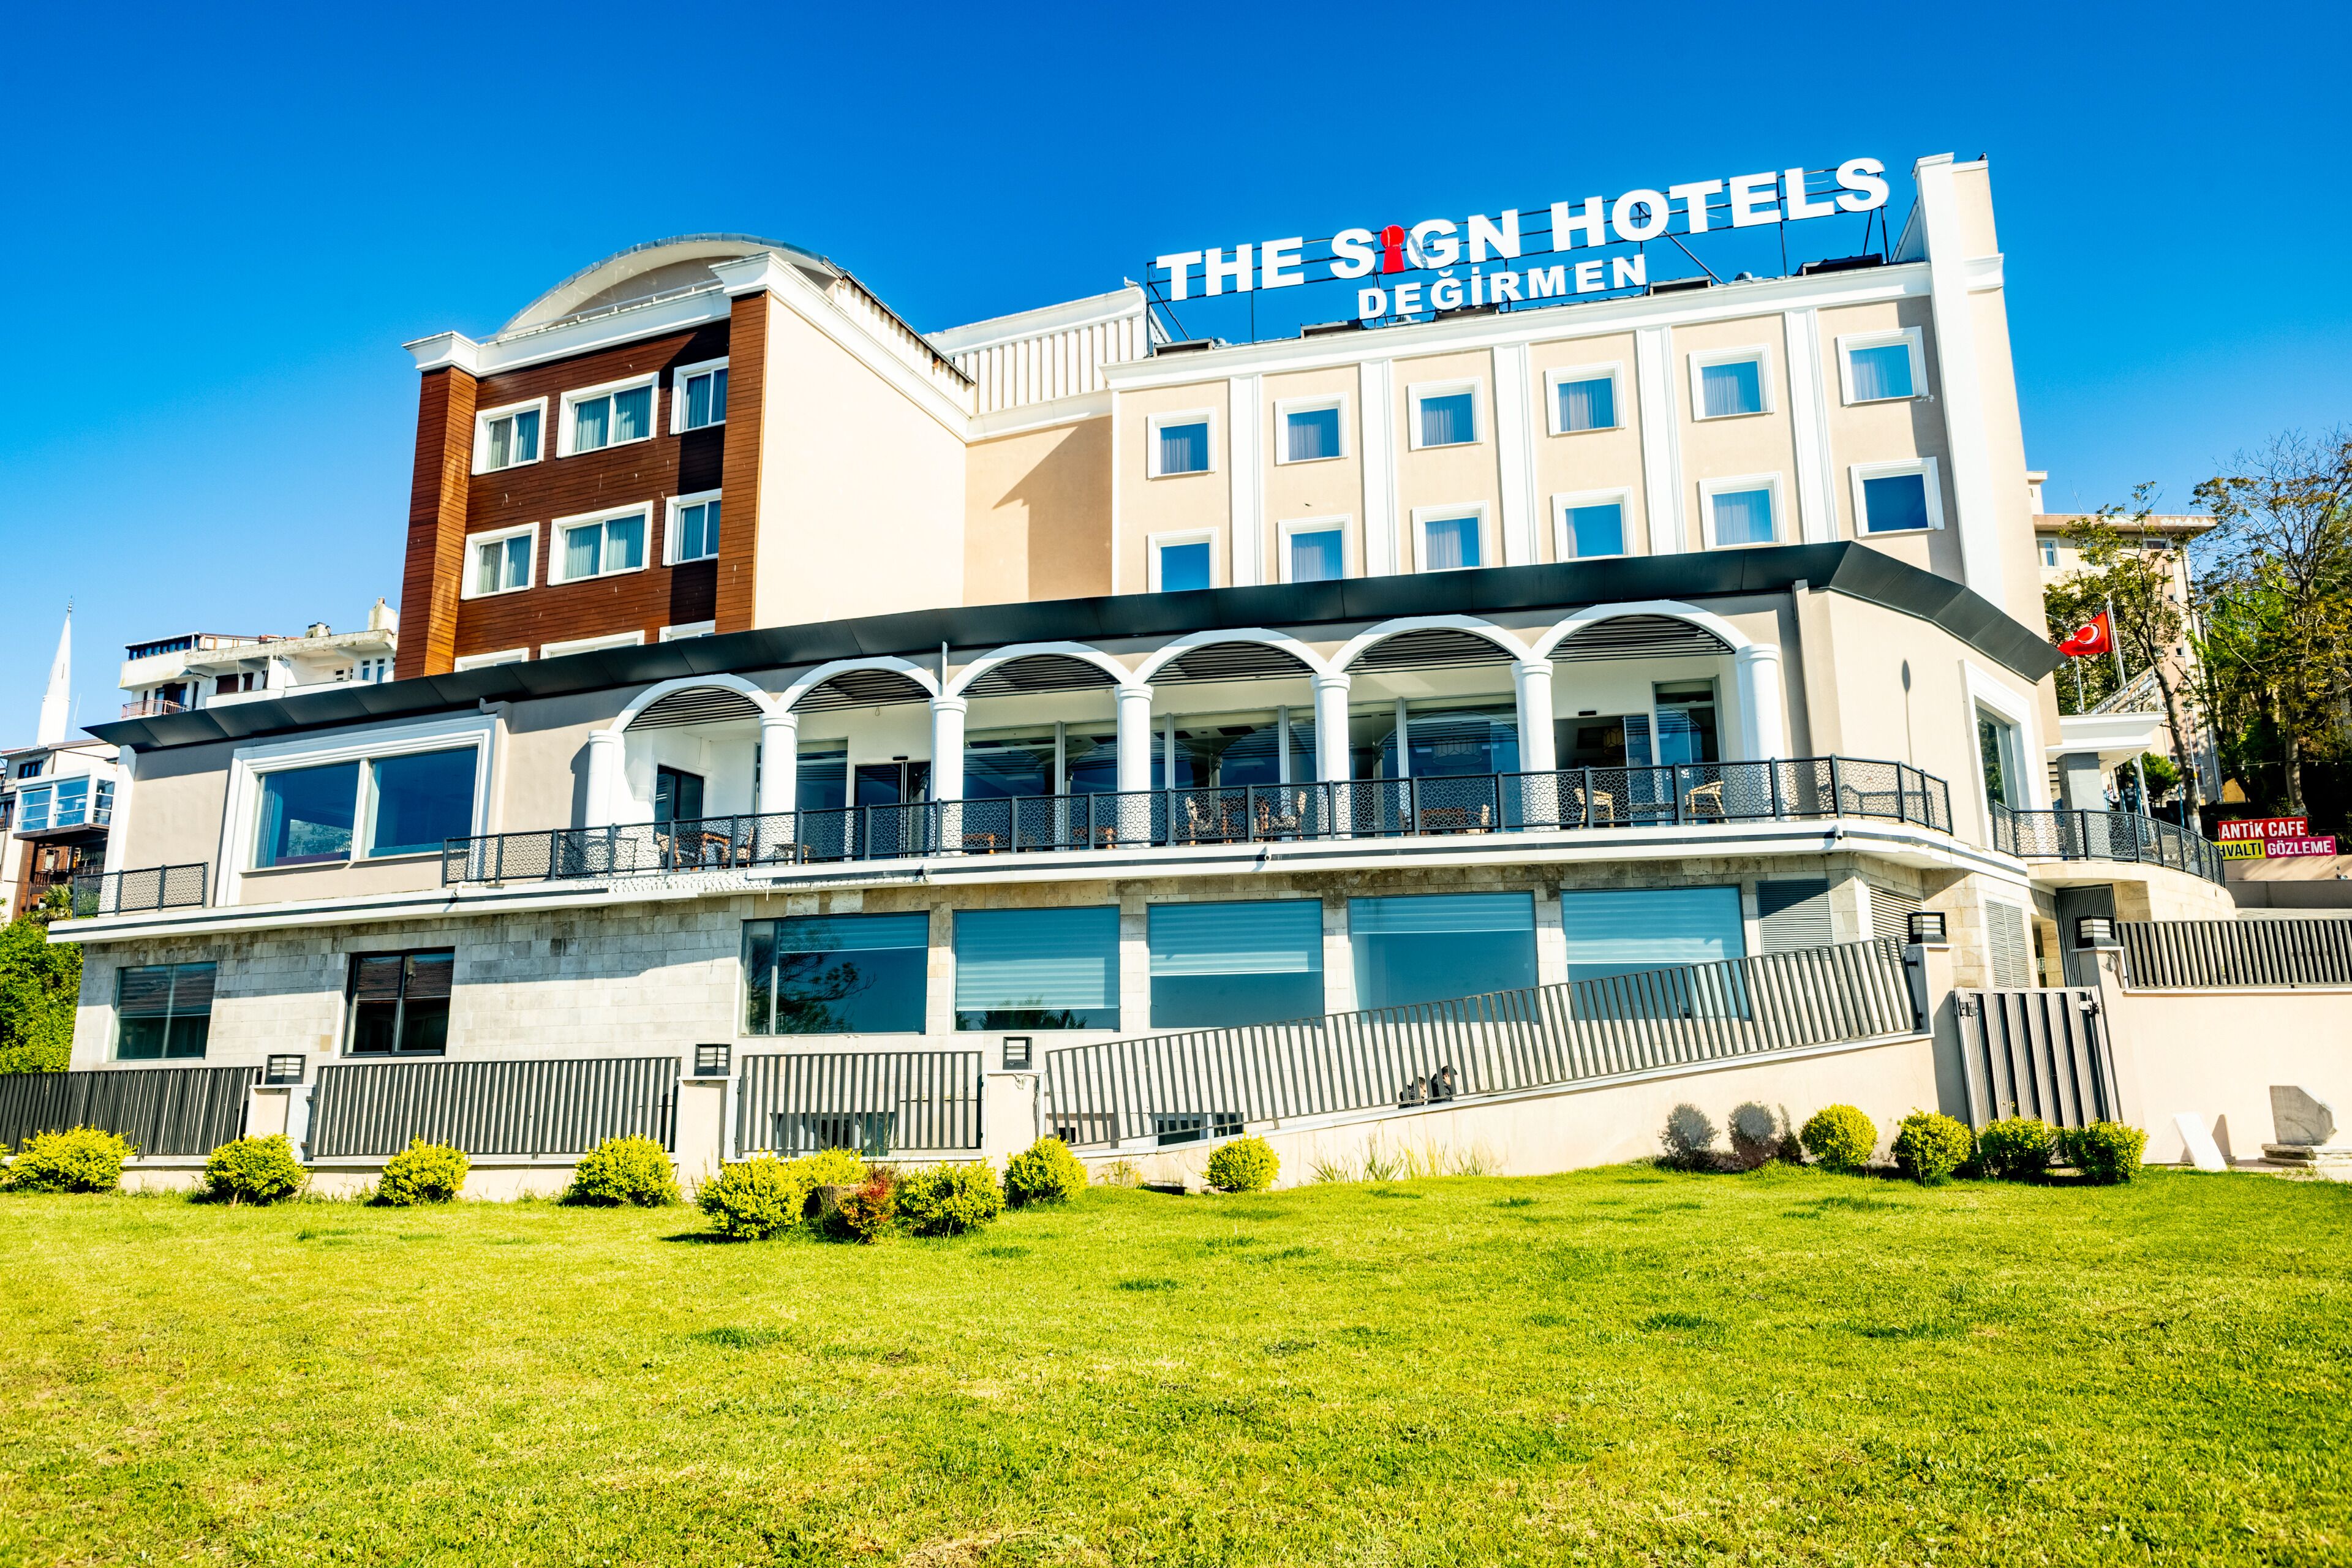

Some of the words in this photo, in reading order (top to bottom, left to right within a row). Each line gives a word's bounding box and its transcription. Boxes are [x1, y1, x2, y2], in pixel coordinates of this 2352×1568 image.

[1156, 236, 1305, 302] THE
[1551, 157, 1890, 252] HOTELS
[1358, 254, 1646, 320] DEĞİRMEN
[2221, 821, 2265, 839] ANTİK
[2268, 821, 2305, 838] CAFE
[2267, 840, 2332, 855] GÖZLEME
